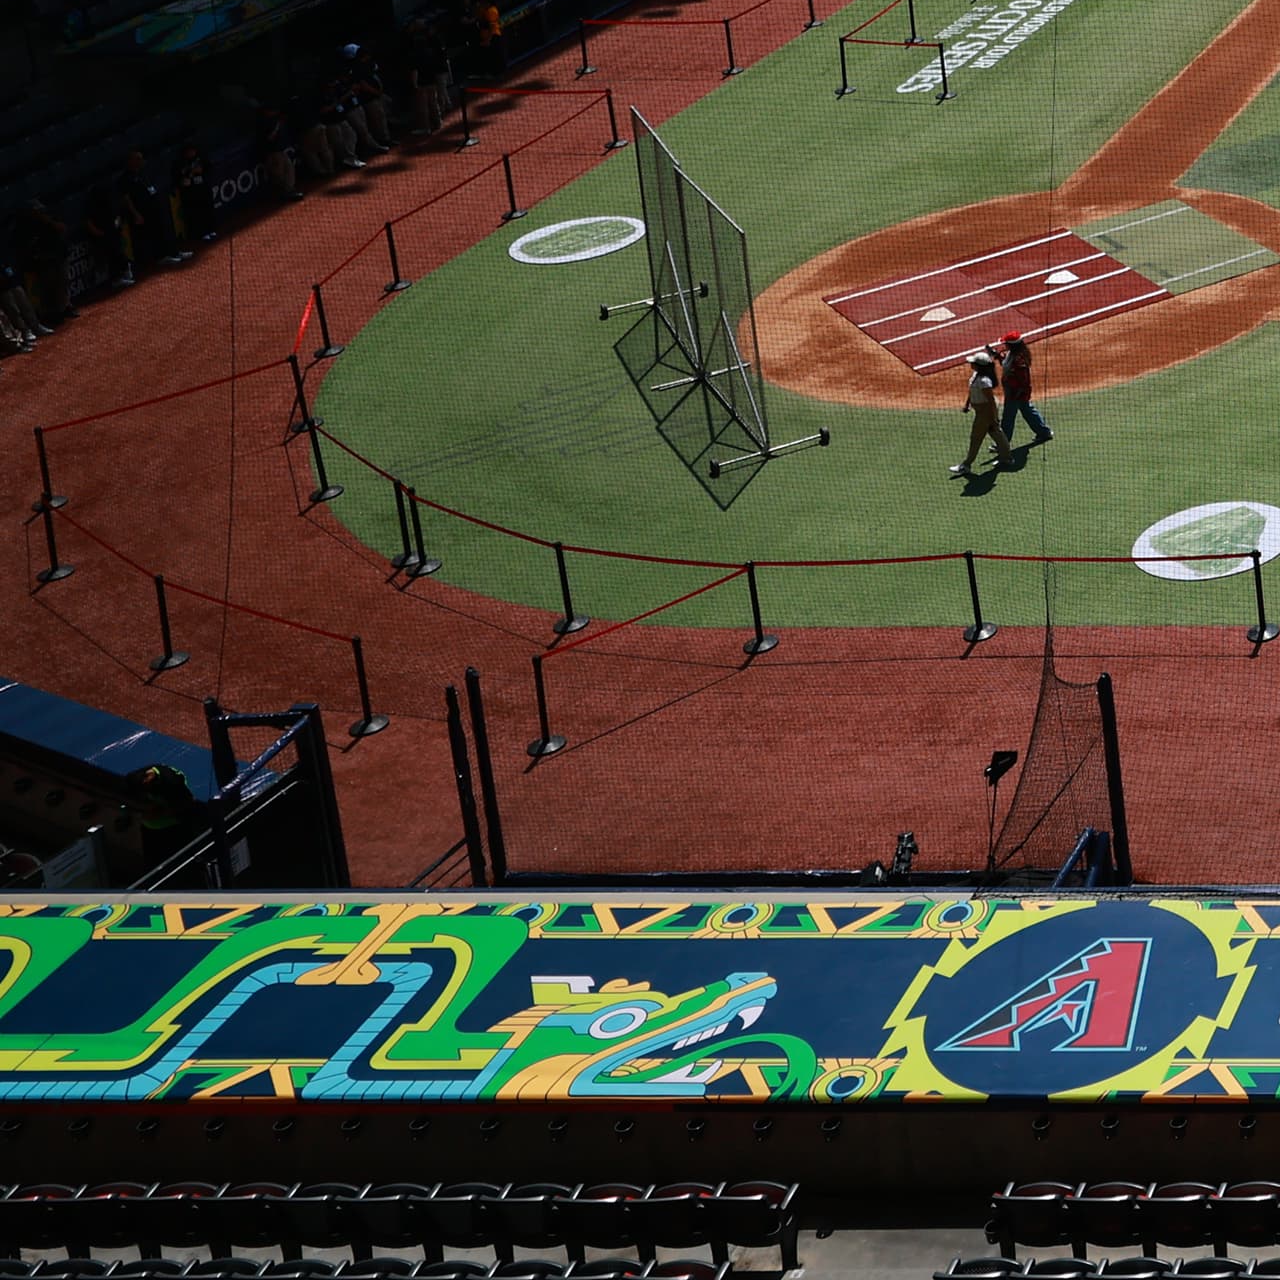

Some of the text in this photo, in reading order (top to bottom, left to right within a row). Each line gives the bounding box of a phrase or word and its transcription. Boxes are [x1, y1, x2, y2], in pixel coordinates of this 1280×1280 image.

[966, 9, 1028, 41] CITY
[896, 40, 987, 94] SERIES
[969, 42, 1019, 69] TOUR
